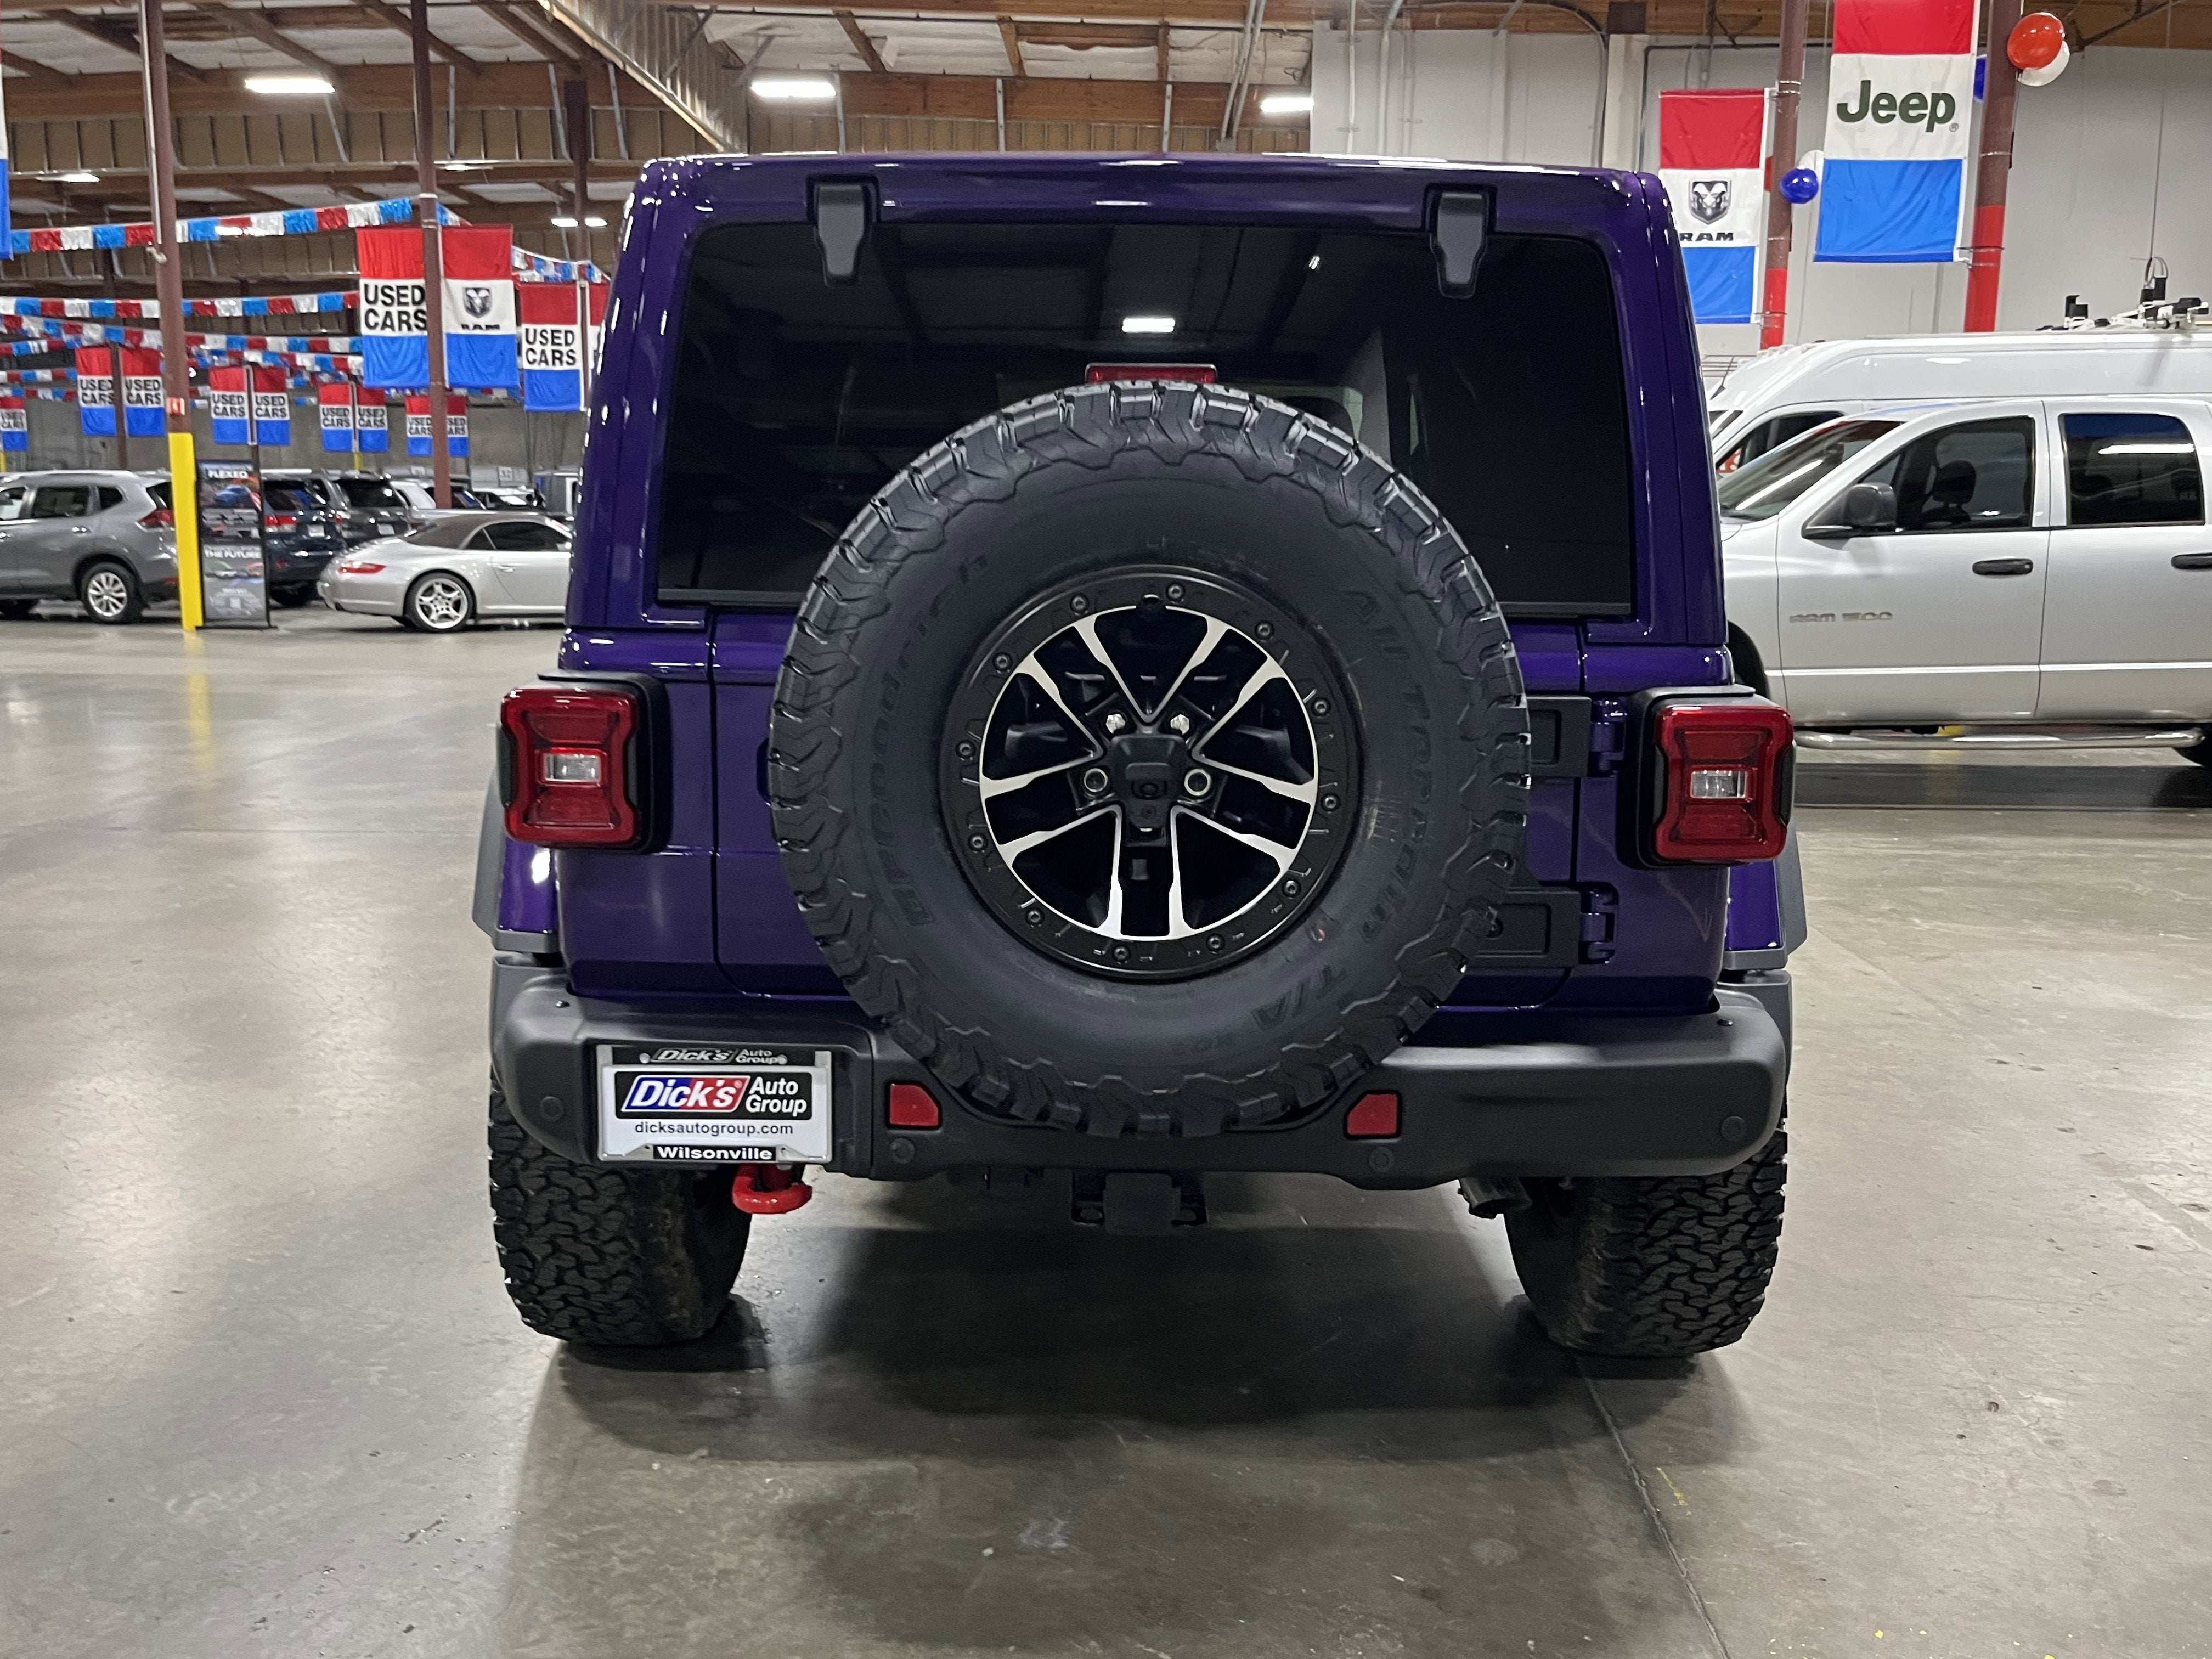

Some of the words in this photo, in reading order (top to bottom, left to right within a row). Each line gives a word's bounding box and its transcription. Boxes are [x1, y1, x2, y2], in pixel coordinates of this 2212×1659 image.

[1837, 80, 1956, 133] Jeep
[1679, 232, 1734, 241] RAM
[364, 284, 426, 306] USED
[365, 308, 427, 331] CARS
[525, 328, 575, 346] USED
[526, 348, 577, 366] CARS
[80, 379, 113, 391] USED
[125, 379, 160, 391] USED
[82, 393, 113, 404] CARS
[127, 393, 161, 405] CARS
[212, 393, 245, 405] USED
[255, 396, 285, 406] USED
[213, 406, 246, 417] CARS
[255, 408, 286, 418] CARS
[322, 408, 350, 417] USED
[358, 408, 385, 417] USED
[323, 419, 351, 428] CARS
[658, 1050, 730, 1062] Dick's
[741, 1049, 772, 1057] Auto
[736, 1056, 778, 1064] Group
[749, 1076, 799, 1096] Auto
[631, 1079, 737, 1108] Dick's
[746, 1094, 808, 1117] Group
[635, 1122, 794, 1137] dicksautogroup.com
[657, 1146, 772, 1160] Wilsonville
